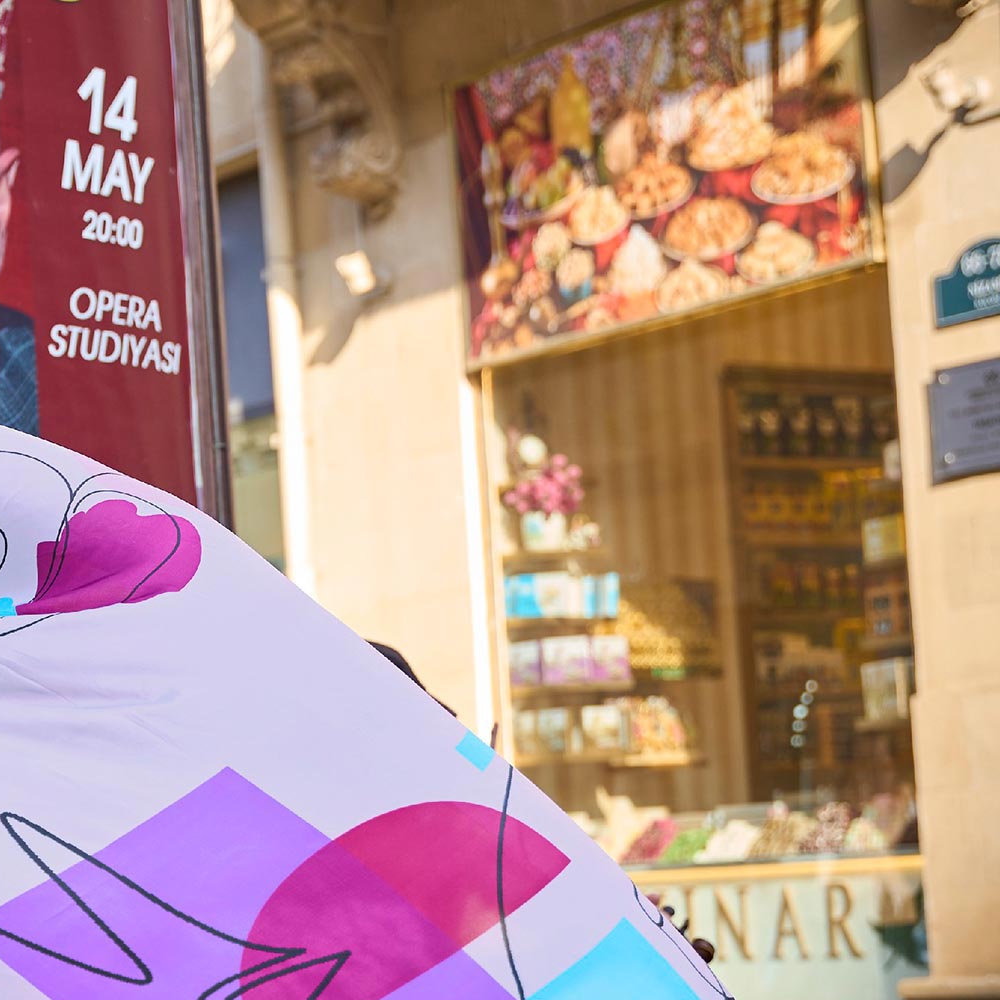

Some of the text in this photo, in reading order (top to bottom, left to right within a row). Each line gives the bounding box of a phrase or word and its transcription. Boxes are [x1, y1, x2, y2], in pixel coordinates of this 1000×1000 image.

[76, 66, 138, 142] 14
[60, 138, 155, 204] MAY
[81, 209, 144, 249] 20:00
[69, 286, 162, 333] OPERA
[47, 323, 182, 375] STUDIYASI
[674, 882, 864, 961] INAR
